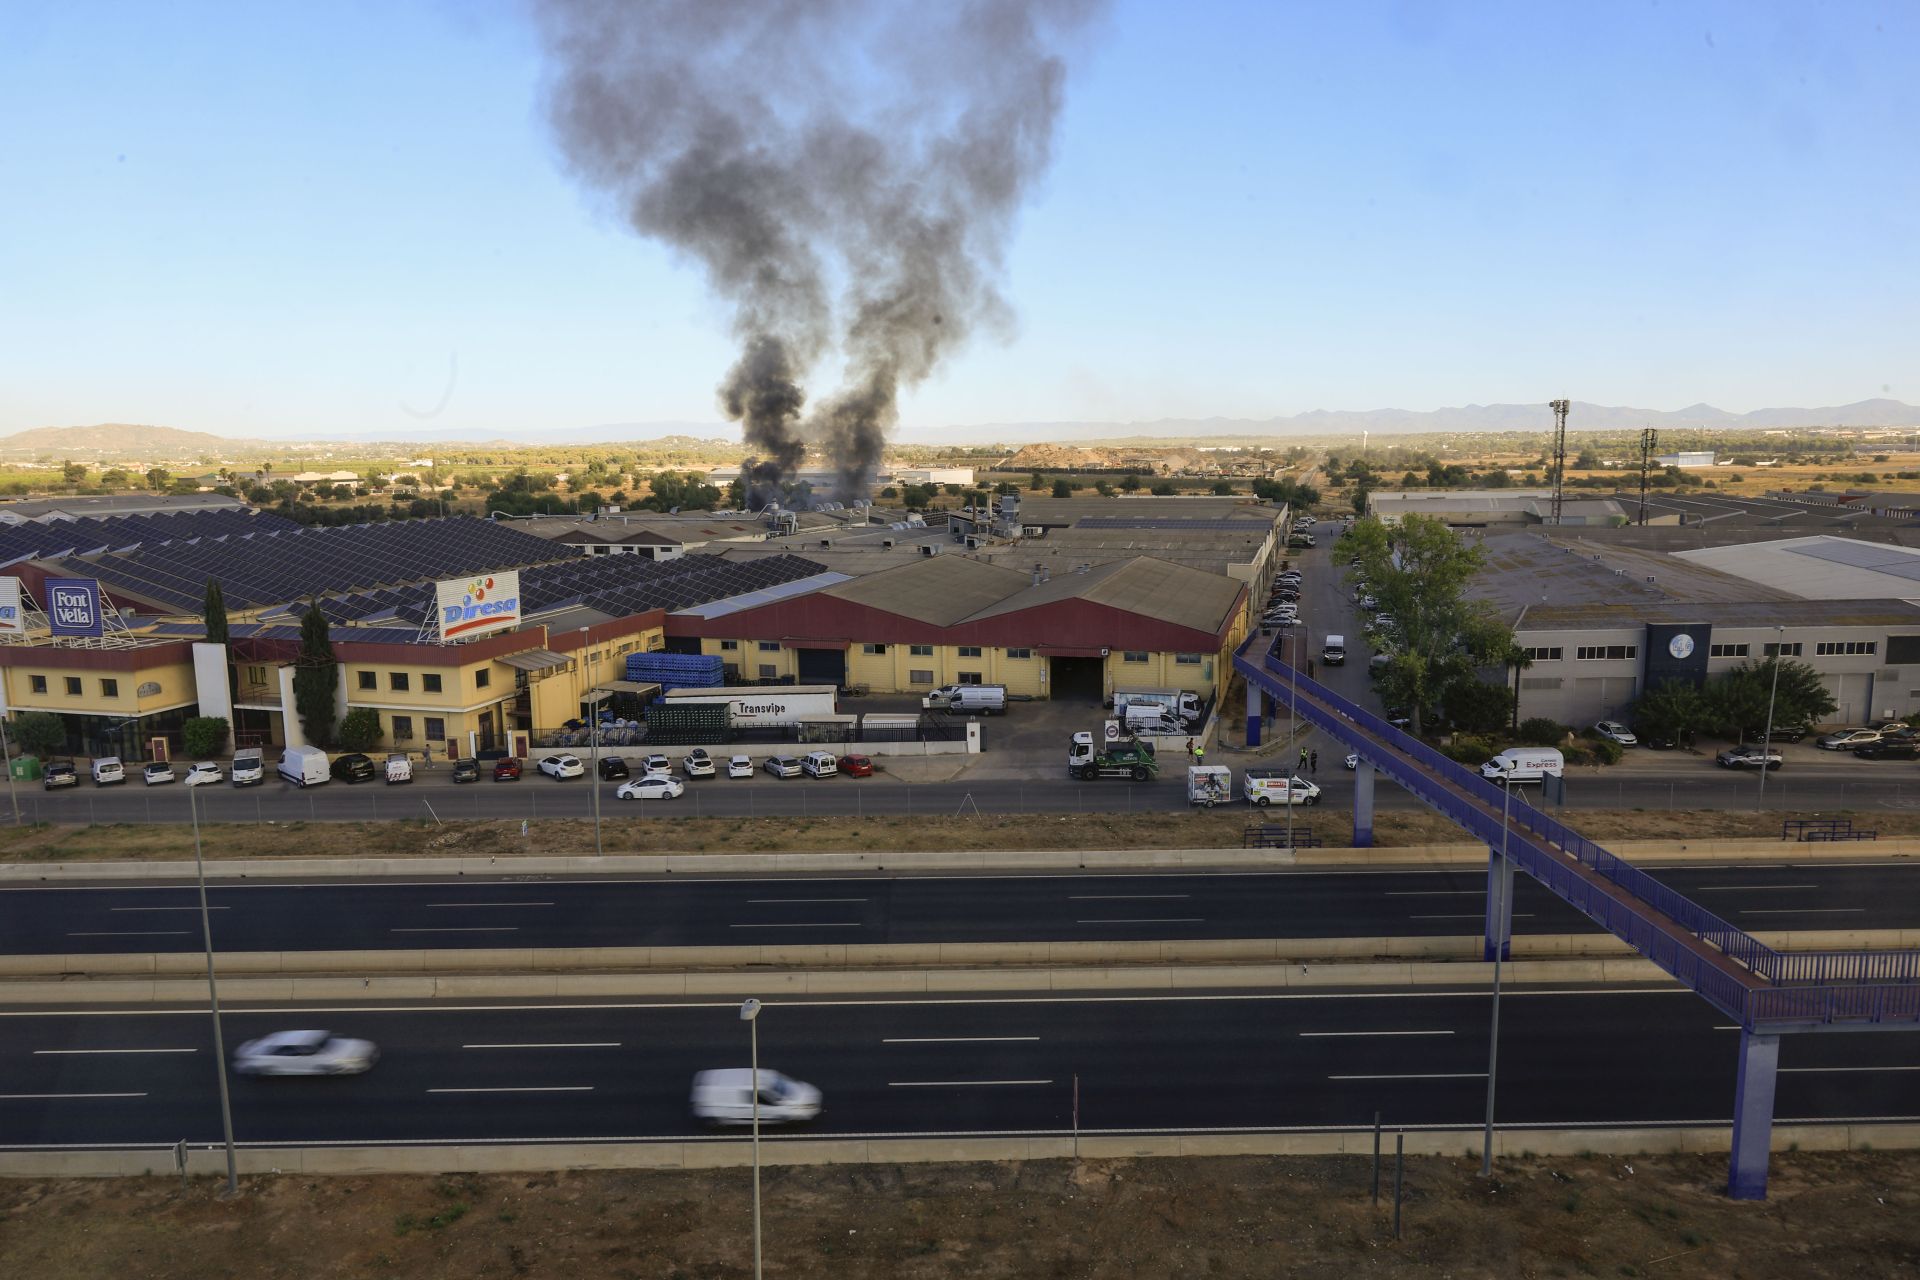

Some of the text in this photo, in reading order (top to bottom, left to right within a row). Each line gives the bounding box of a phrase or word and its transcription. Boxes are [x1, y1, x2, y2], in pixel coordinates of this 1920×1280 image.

[56, 591, 88, 607] Font
[57, 608, 90, 623] Vella
[443, 595, 517, 624] Diresa
[739, 702, 786, 716] Transvipe
[1526, 761, 1557, 769] Express
